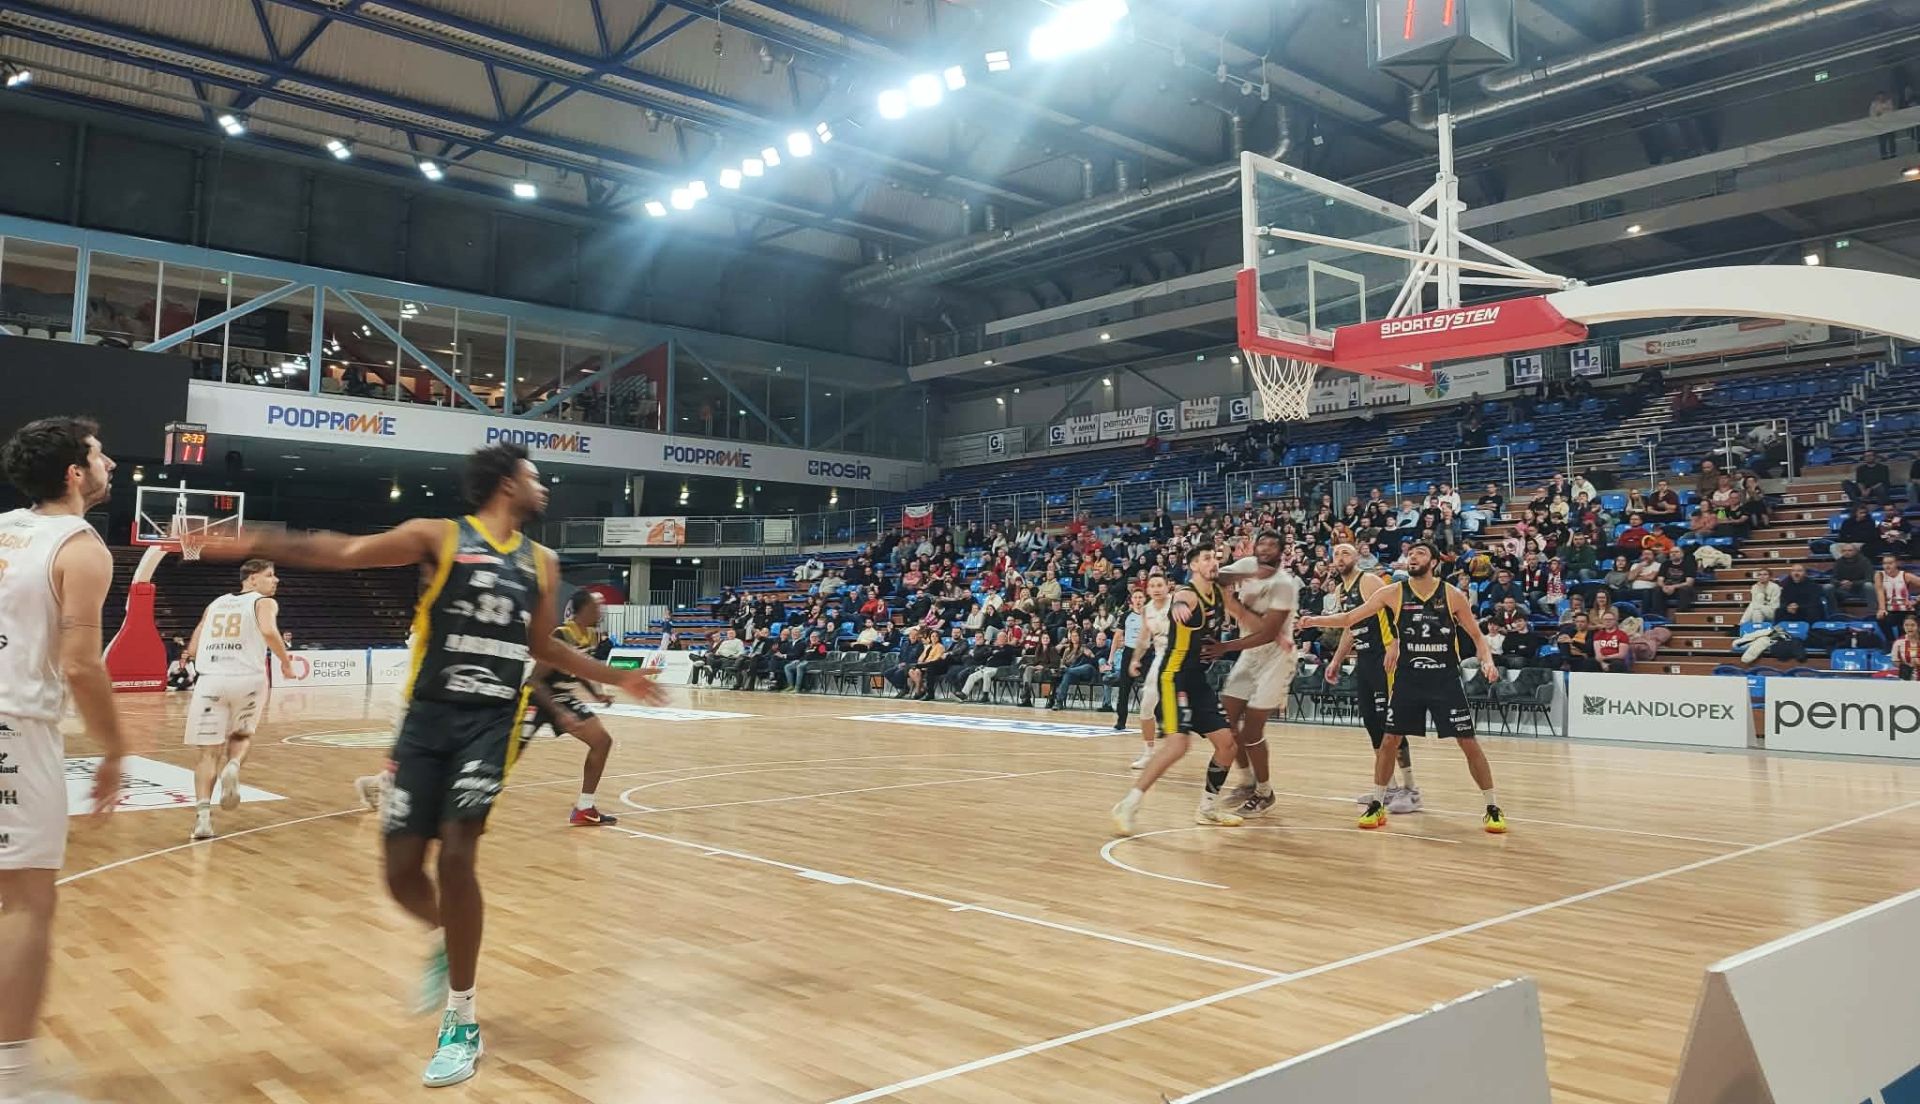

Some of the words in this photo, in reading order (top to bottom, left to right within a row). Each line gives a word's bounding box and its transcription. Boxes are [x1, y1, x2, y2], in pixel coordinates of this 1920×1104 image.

[1380, 306, 1500, 338] SPORTSYSTEM
[182, 433, 205, 444] 2:33
[211, 613, 242, 638] 58
[1421, 624, 1431, 637] 2
[313, 670, 351, 678] Polska
[1608, 699, 1735, 721] HANDLOPEX
[1774, 699, 1920, 741] pemp
